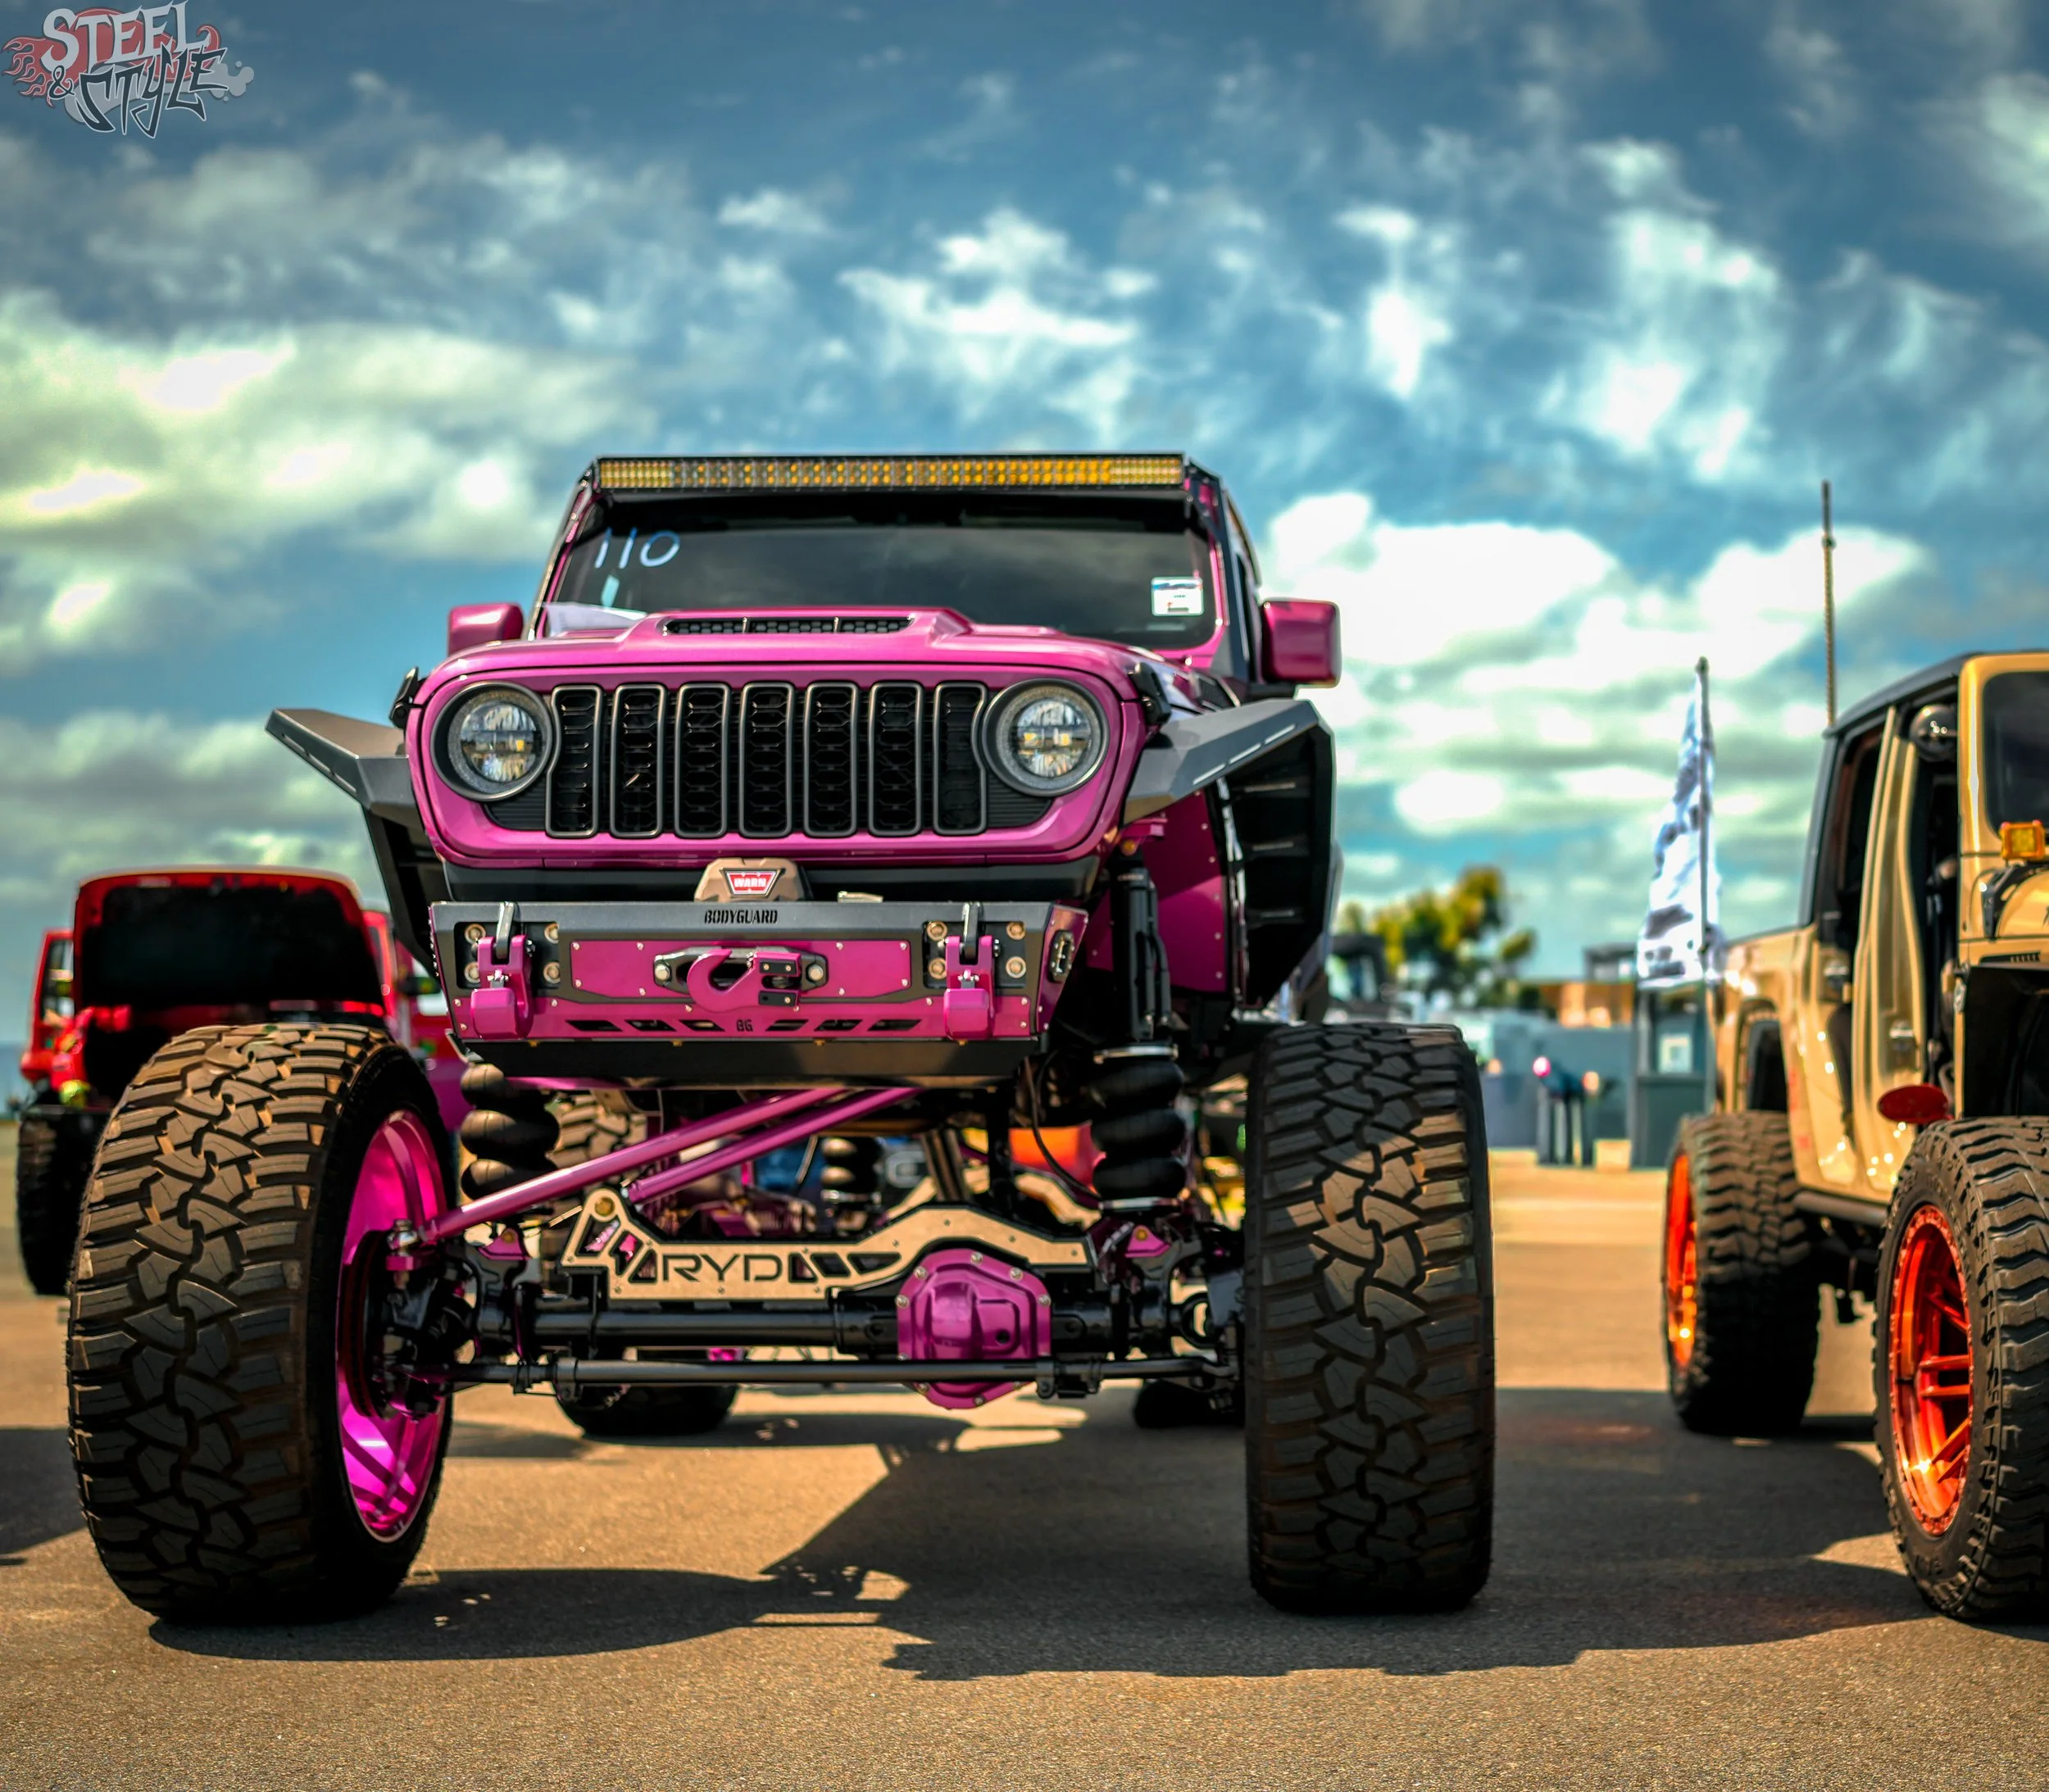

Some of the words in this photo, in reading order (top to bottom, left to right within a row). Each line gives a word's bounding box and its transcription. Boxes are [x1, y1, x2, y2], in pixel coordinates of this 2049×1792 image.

[594, 527, 680, 569] 110
[734, 877, 767, 887] WARN
[705, 909, 778, 924] BODYGUARD
[736, 1018, 753, 1032] BG
[662, 1254, 783, 1282] RYD
